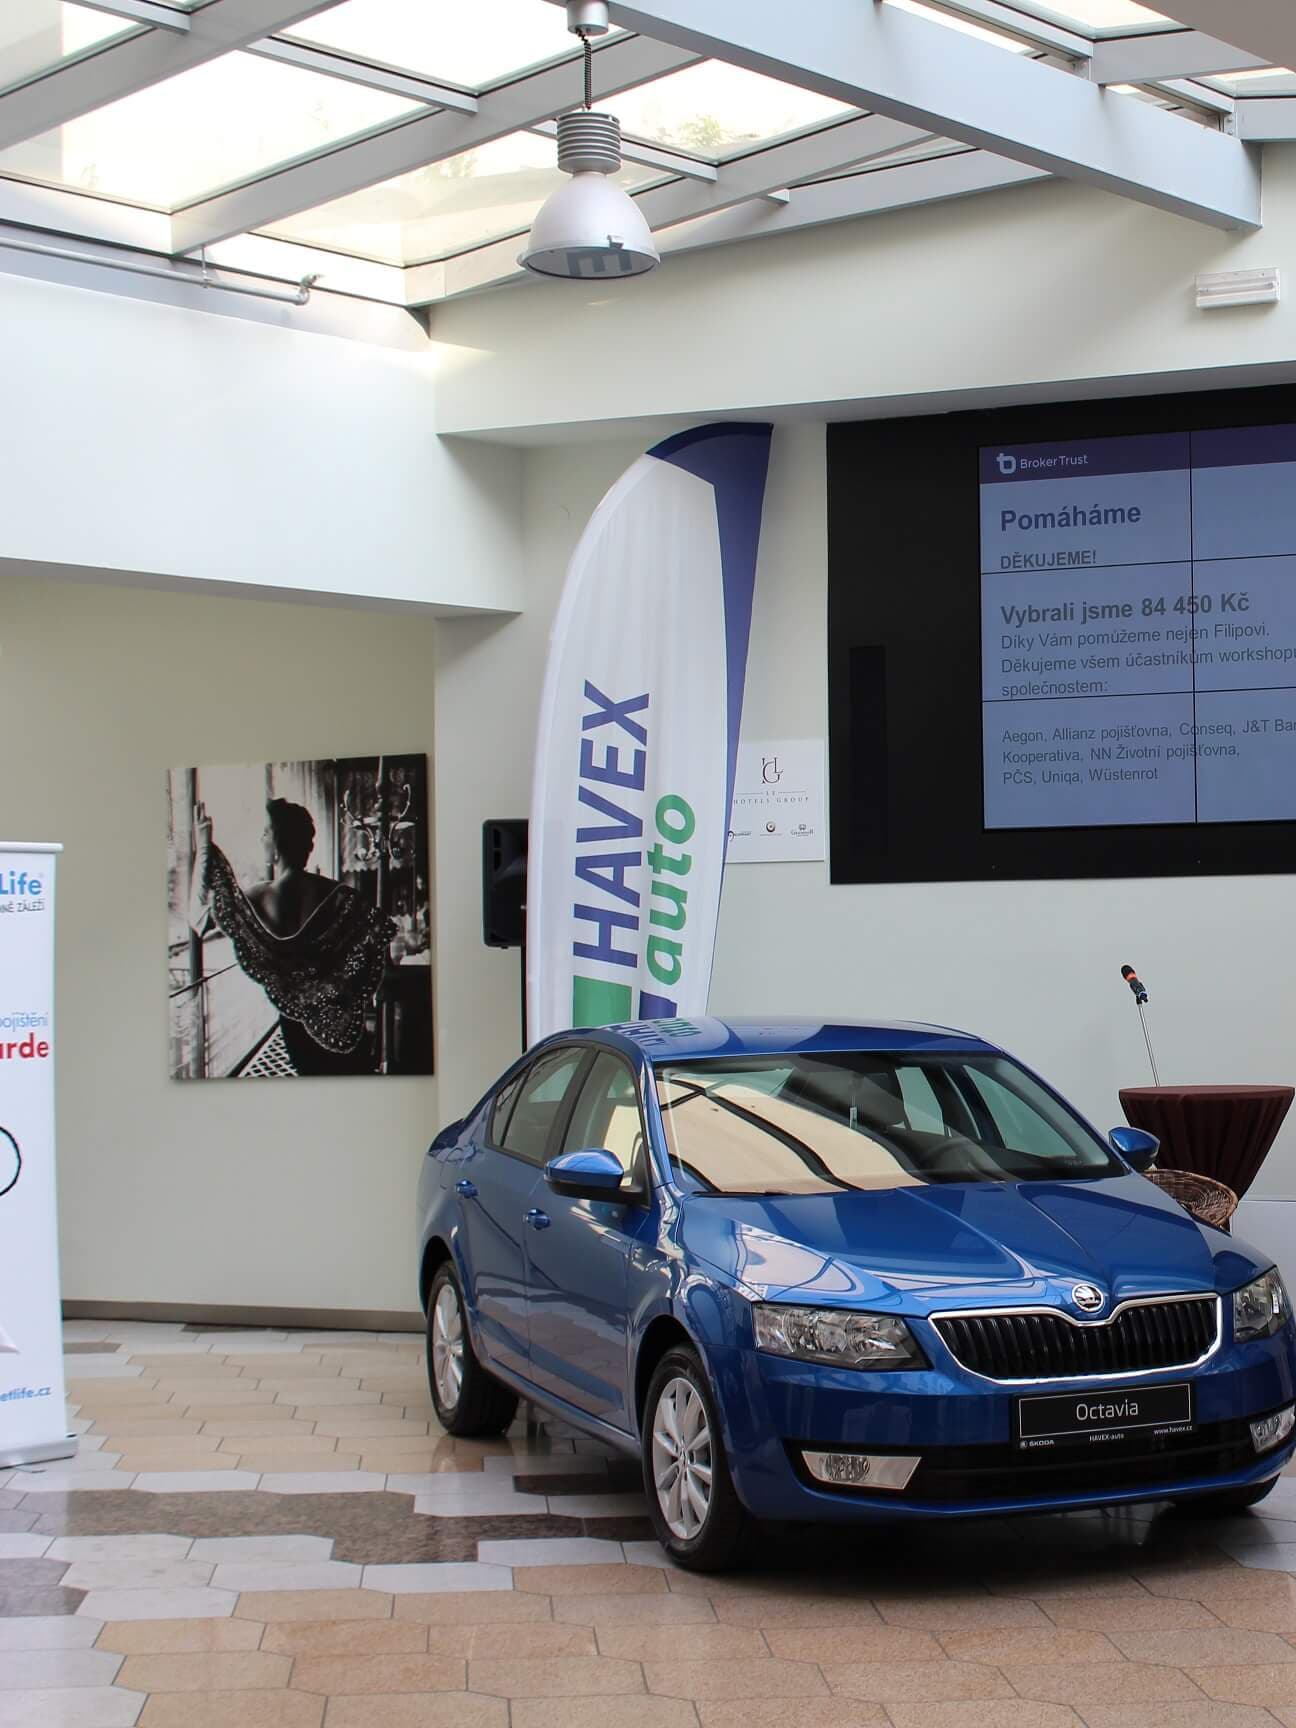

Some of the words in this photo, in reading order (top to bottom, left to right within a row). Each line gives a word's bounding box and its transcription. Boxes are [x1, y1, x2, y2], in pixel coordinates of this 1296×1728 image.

[1001, 503, 1142, 531] Pomáháme
[1000, 550, 1097, 570] DĚKUJEME!
[1000, 602, 1075, 628] Vybrali
[1080, 602, 1133, 625] jsme
[1141, 597, 1166, 617] 84
[1173, 594, 1212, 616] 450
[1221, 592, 1250, 613] Kč
[1001, 633, 1034, 652] Díky
[1039, 632, 1073, 648] Vám
[1077, 629, 1161, 649] pomůžeme
[1165, 625, 1209, 644] nejen
[1214, 621, 1270, 641] Filipovi.
[1001, 657, 1077, 674] Děkujeme
[1081, 655, 1120, 669] všem
[1002, 680, 1109, 700] společnostem:
[1002, 729, 1048, 745] Aegon,
[1052, 727, 1096, 742] Allianz
[1100, 724, 1172, 742] pojišťovna,
[1242, 719, 1271, 734] J&T
[1002, 749, 1084, 765] Kooperativa,
[1090, 747, 1112, 761] NN
[1116, 744, 1161, 760] Životní
[1041, 769, 1083, 785] Uniqa,
[1088, 767, 1158, 782] Wüstenrot
[573, 679, 649, 968] HAVEX
[0, 870, 42, 895] Life
[646, 794, 696, 986] auto
[0, 1011, 49, 1032] ojištění
[0, 1032, 49, 1059] rde
[0, 1386, 51, 1402] etlife.cz
[1076, 1399, 1139, 1421] Octavia
[1153, 1425, 1193, 1436] www.havex.cz
